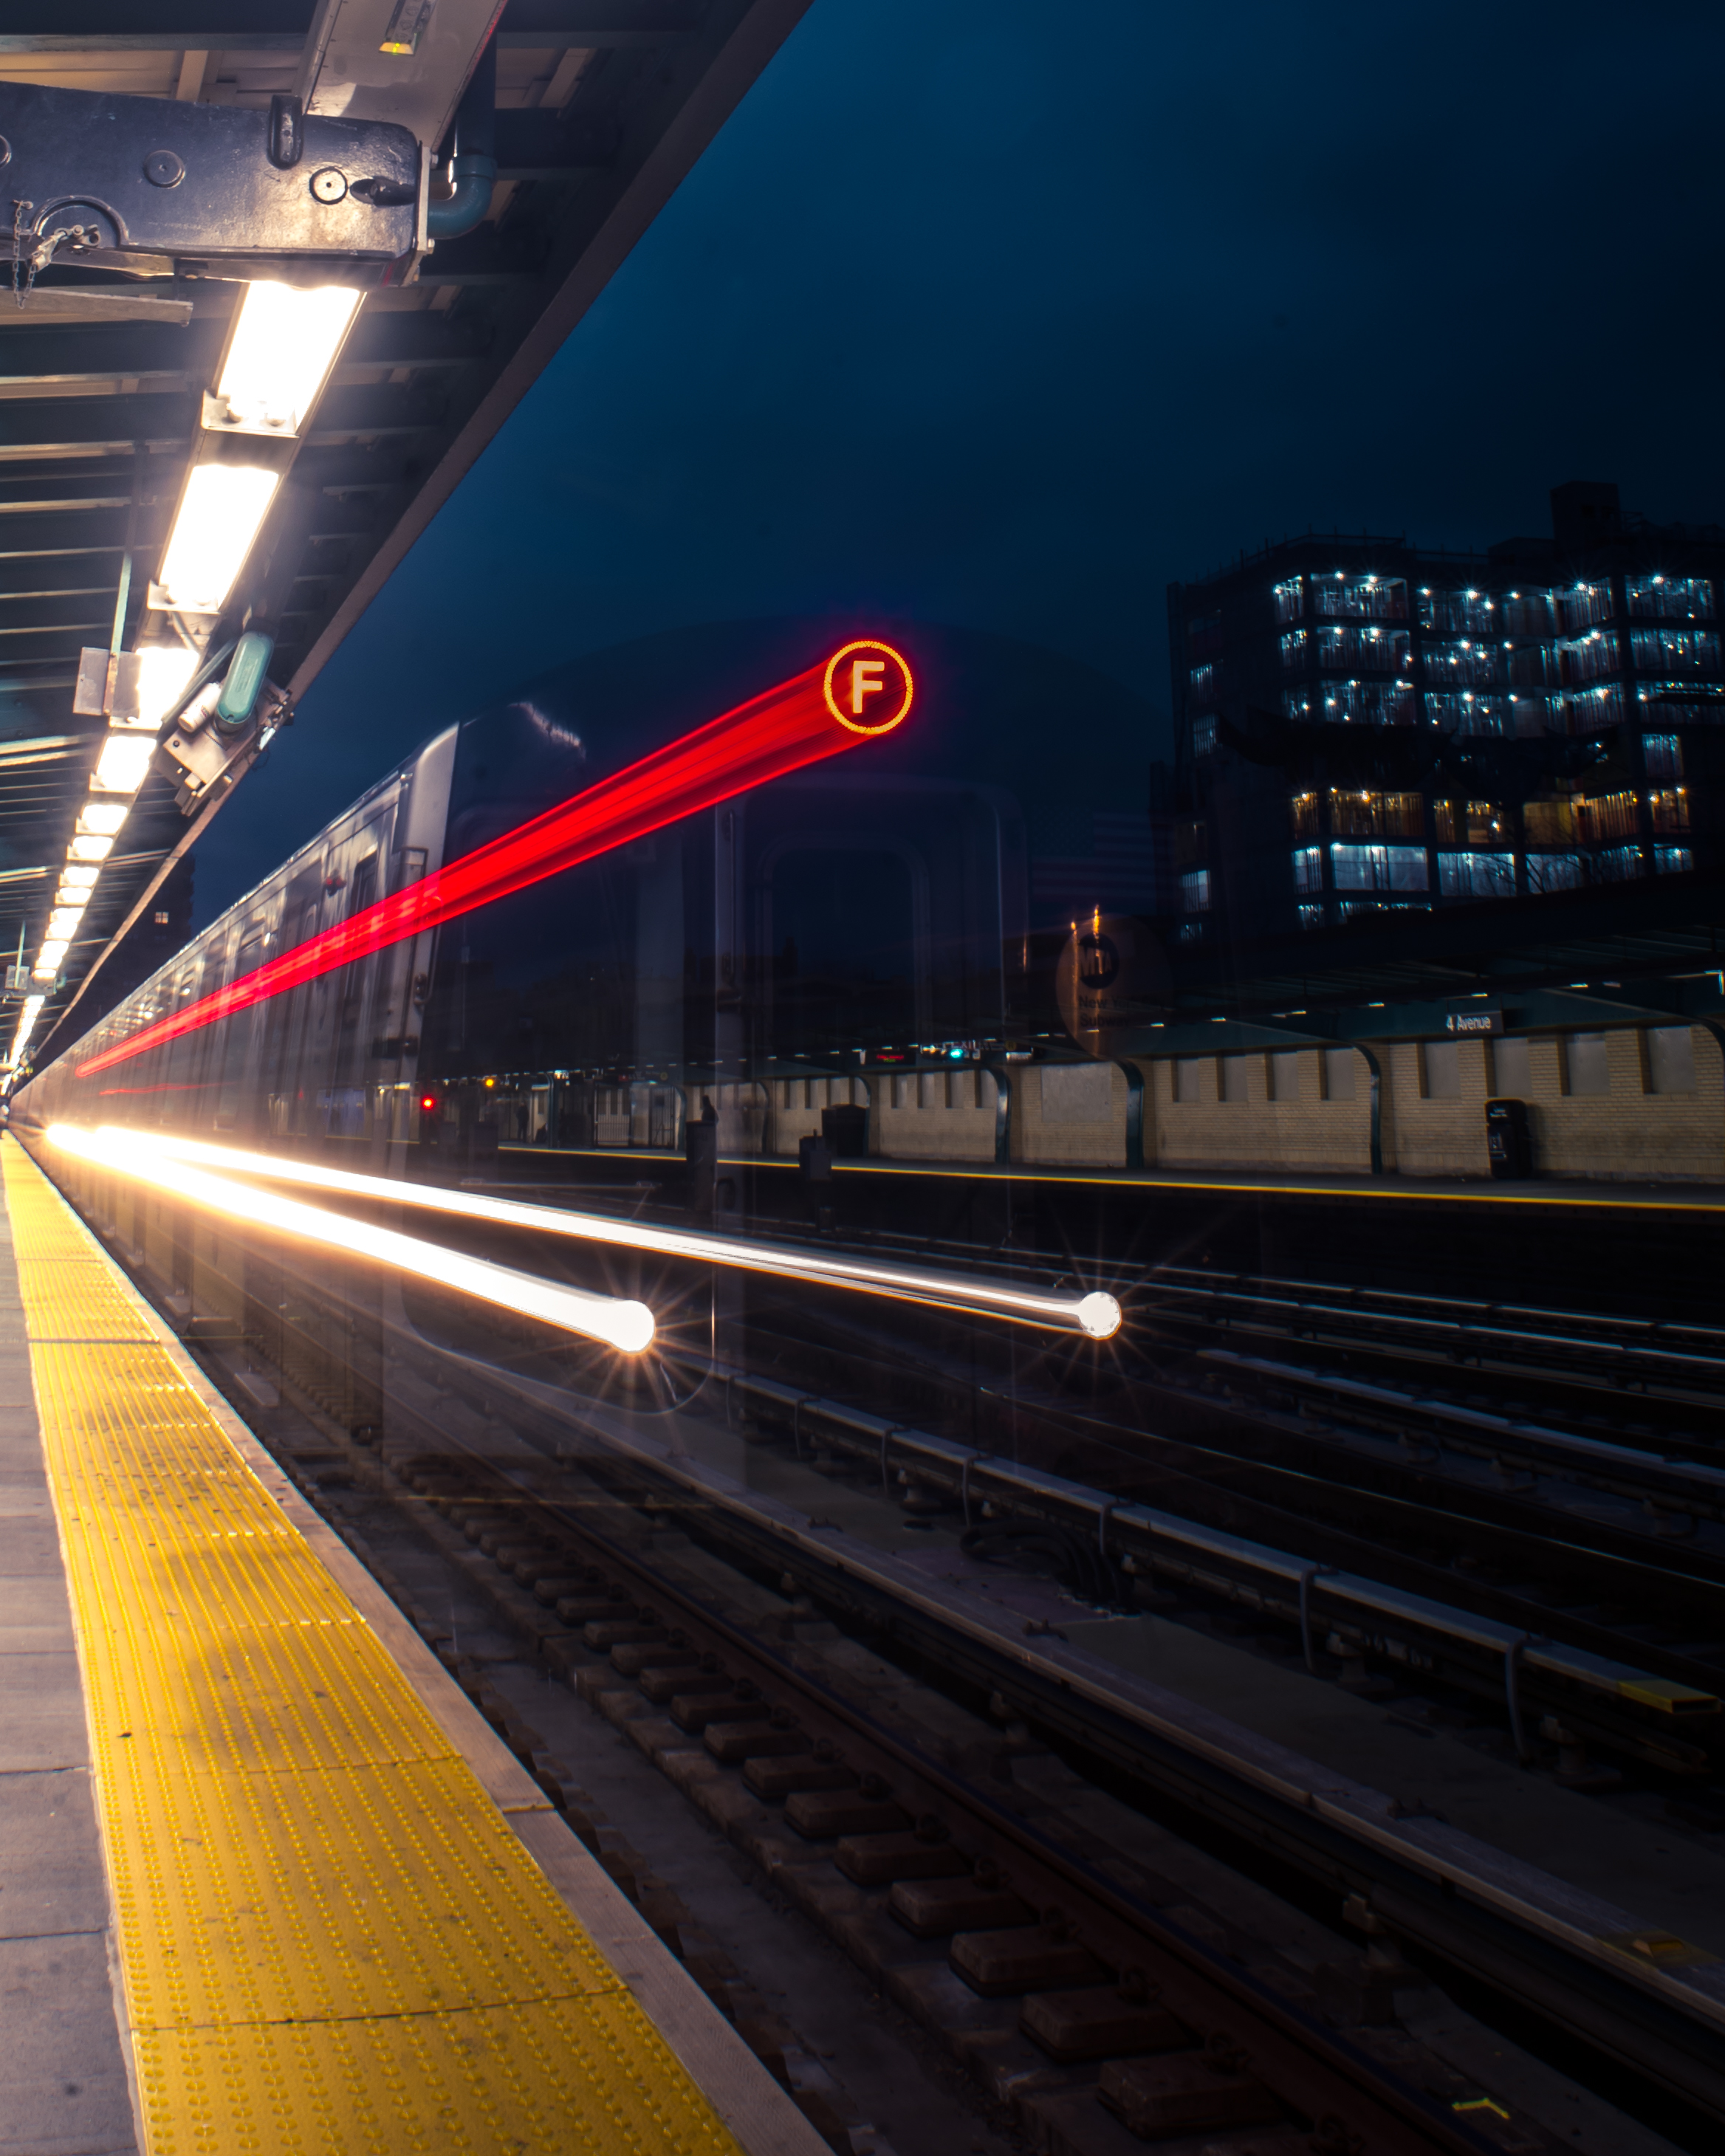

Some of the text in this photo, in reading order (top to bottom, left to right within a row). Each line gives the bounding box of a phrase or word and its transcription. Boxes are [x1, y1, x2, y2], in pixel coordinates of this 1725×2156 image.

[852, 659, 885, 714] F
[1079, 944, 1114, 978] MTA
[1078, 995, 1107, 1009] New
[1080, 1013, 1130, 1027] Subway
[1446, 1015, 1492, 1031] 4 Avenue
